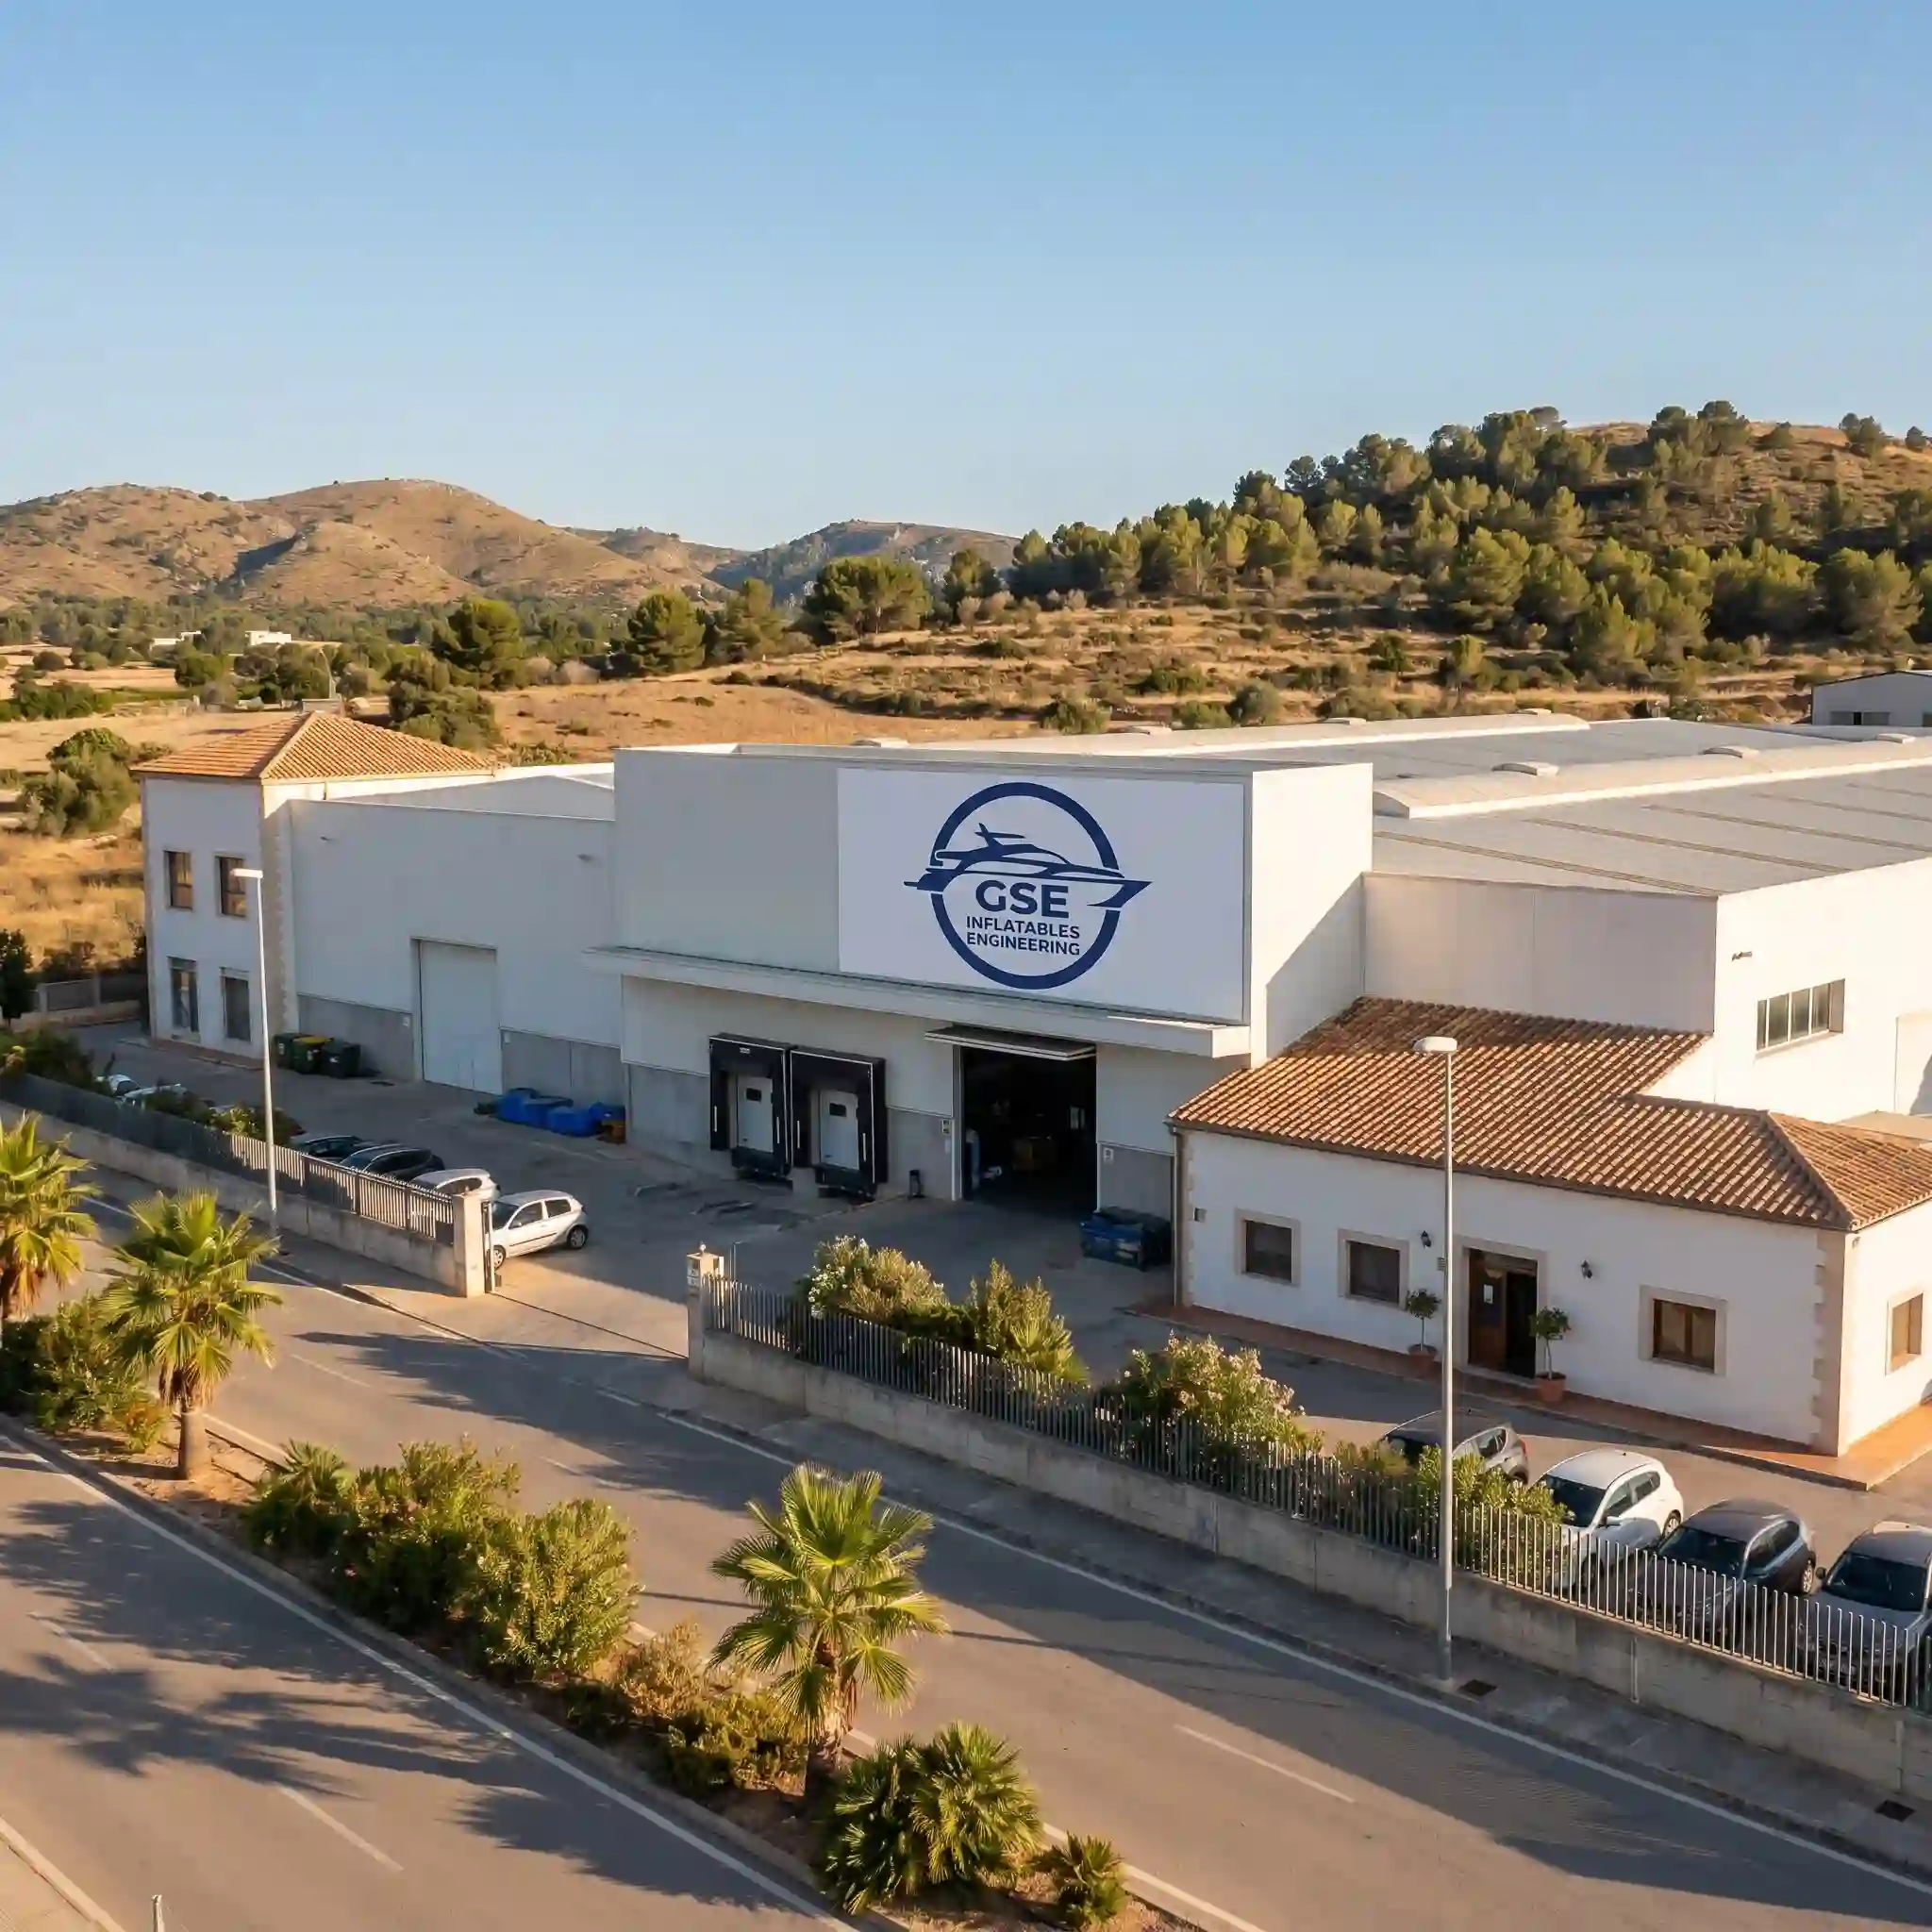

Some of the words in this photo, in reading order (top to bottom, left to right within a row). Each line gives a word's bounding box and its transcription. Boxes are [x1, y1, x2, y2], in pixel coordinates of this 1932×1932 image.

[975, 879, 1070, 919] GSE
[966, 915, 1081, 940] INFLATABLES
[966, 931, 1081, 957] ENGINEERING
